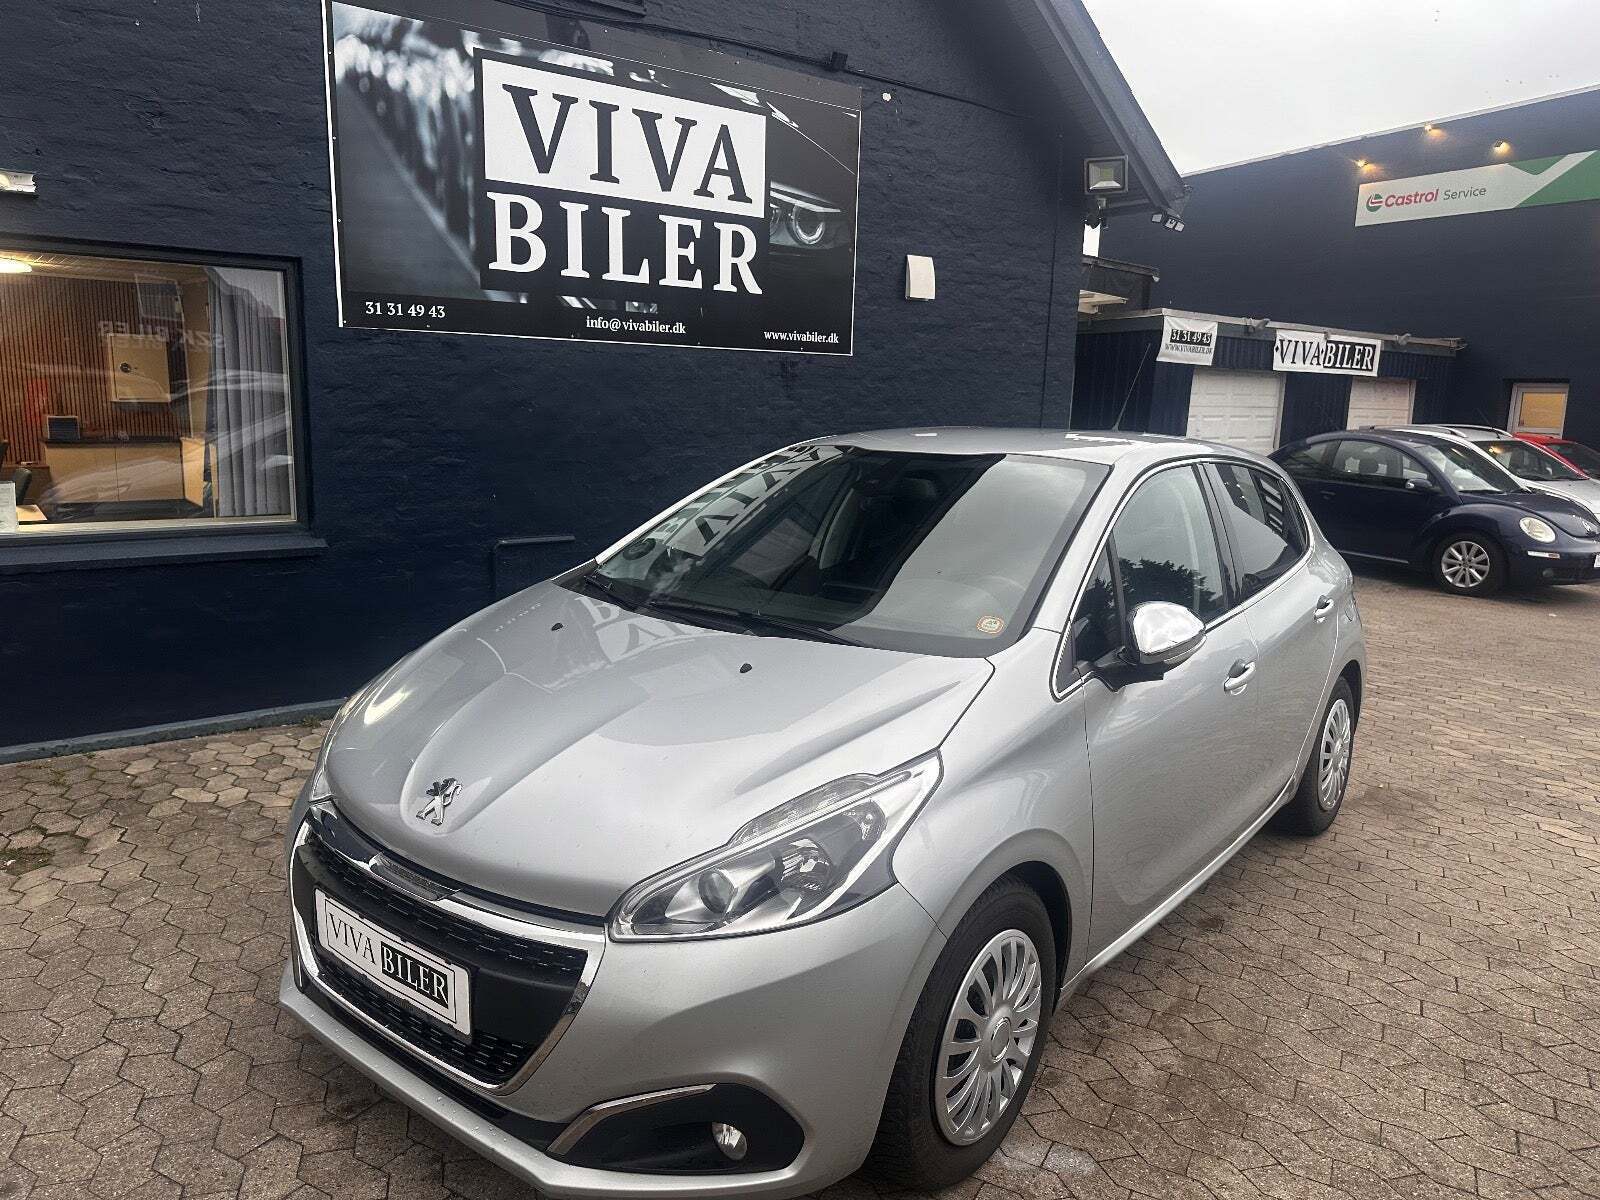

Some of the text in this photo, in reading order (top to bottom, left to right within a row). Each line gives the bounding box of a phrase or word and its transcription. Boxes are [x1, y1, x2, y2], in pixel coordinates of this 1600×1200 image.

[501, 83, 755, 205] VIVA
[1384, 186, 1487, 208] Castrol Service
[486, 190, 763, 295] BILER
[365, 301, 446, 319] 31 31 49 43
[586, 315, 687, 335] info@vivabiler.dk
[763, 330, 840, 344] www.vivabiler.dk
[1171, 329, 1211, 344] 31 31 49 43
[1278, 338, 1374, 370] VIVA BILER
[329, 913, 449, 1005] VIVA BILER
